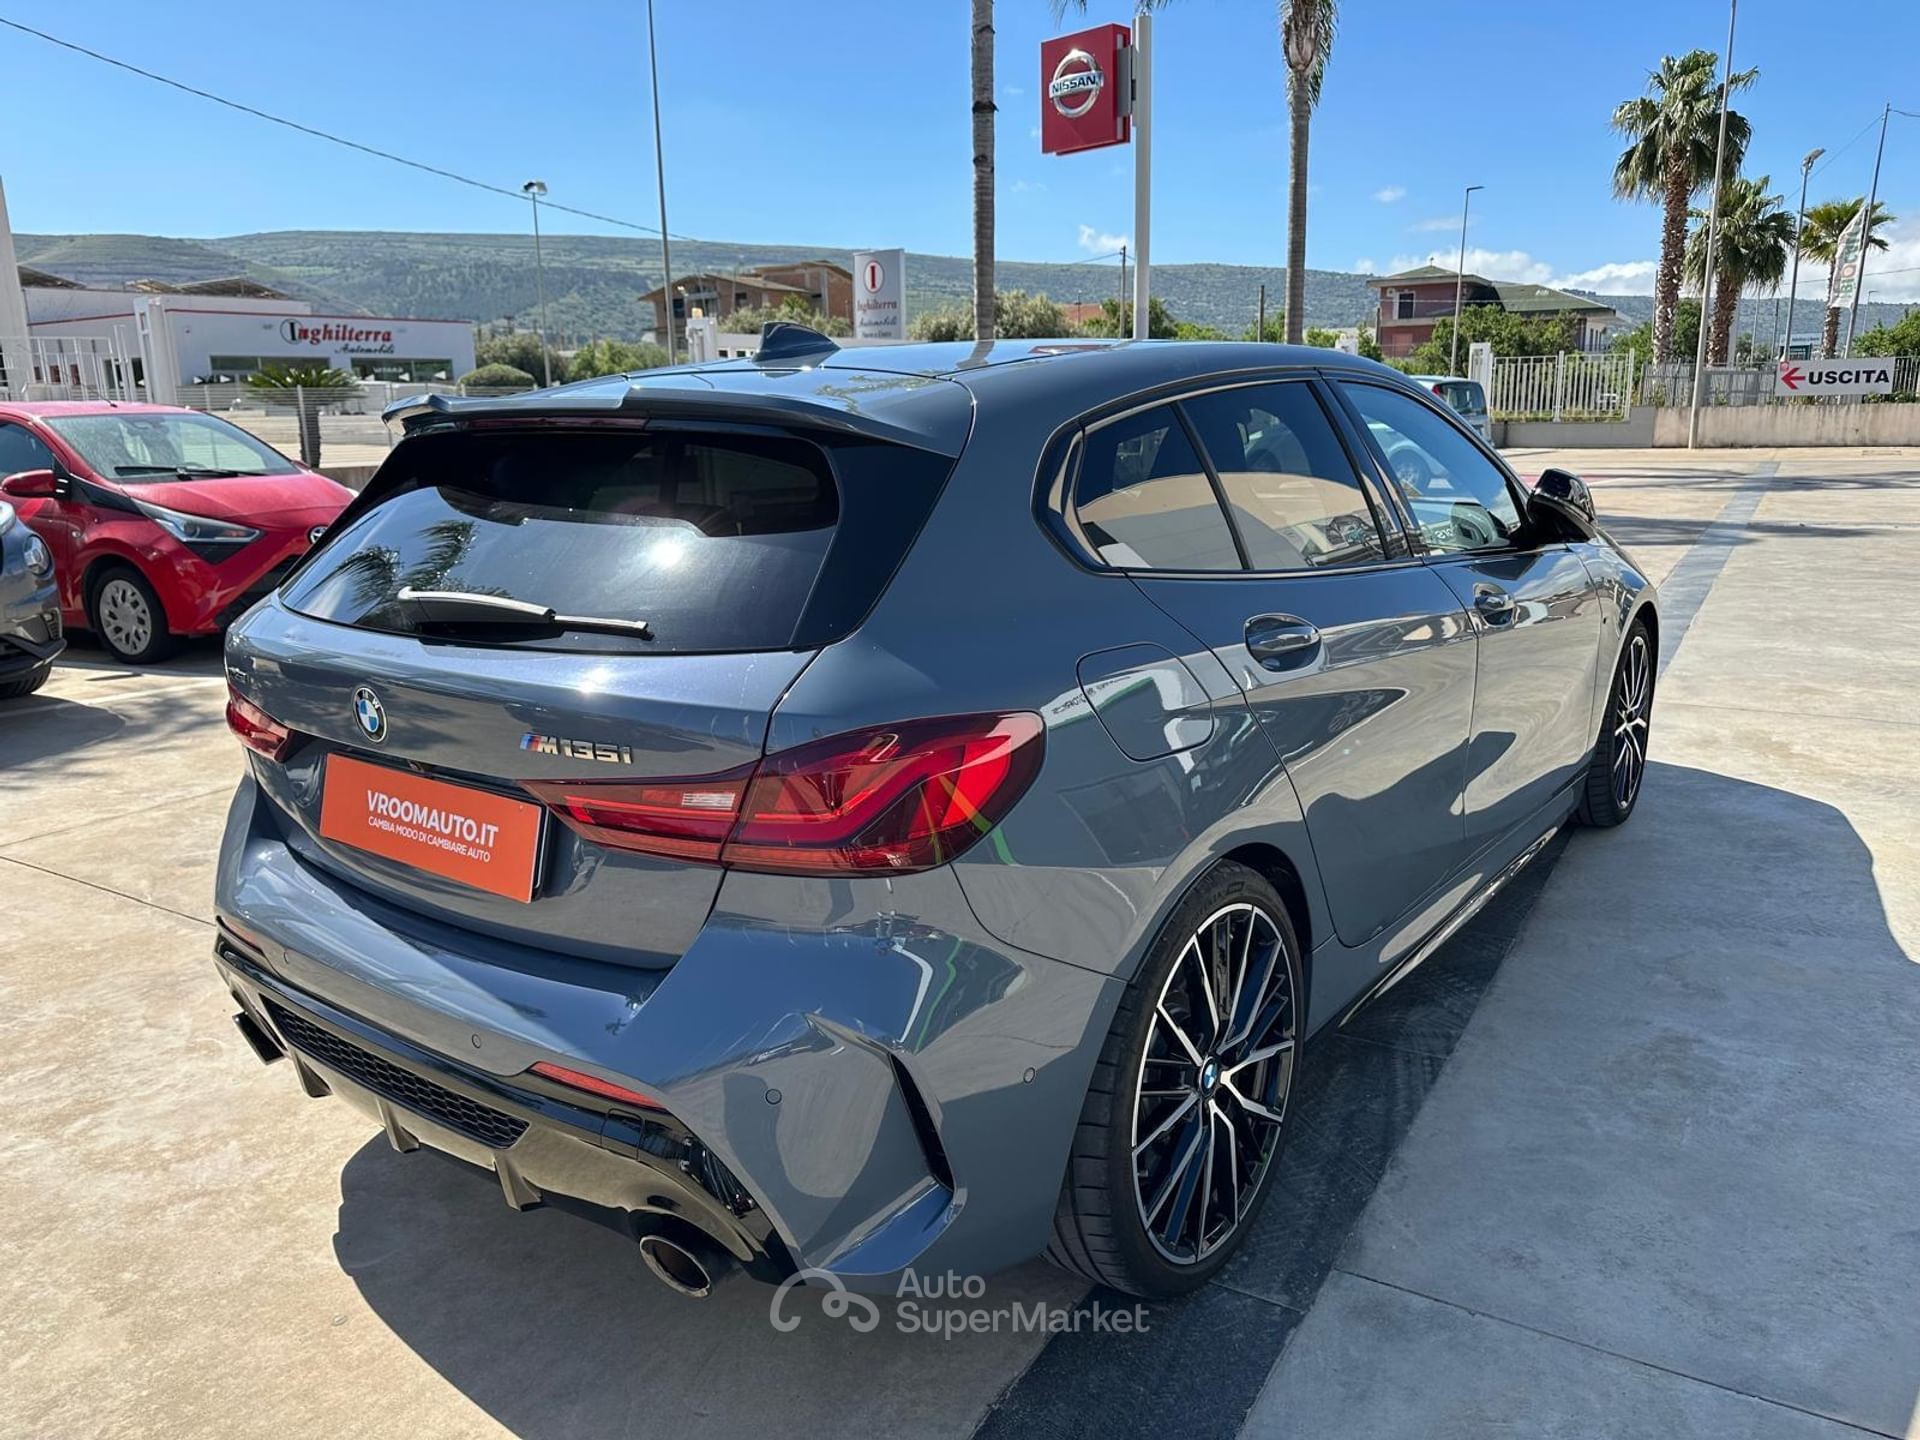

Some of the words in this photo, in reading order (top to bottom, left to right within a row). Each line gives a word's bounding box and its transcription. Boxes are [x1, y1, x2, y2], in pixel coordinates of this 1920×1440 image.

[1052, 75, 1097, 94] NISSAN
[289, 321, 393, 345] Inghilterra
[1808, 369, 1890, 385] USCITA
[367, 789, 499, 848] VROOMAUTO.IT
[368, 815, 395, 833] CAMBIA
[395, 824, 418, 840] MODO
[418, 831, 427, 843] DI
[427, 834, 468, 856] CAMBIARE
[467, 847, 491, 863] AUTO
